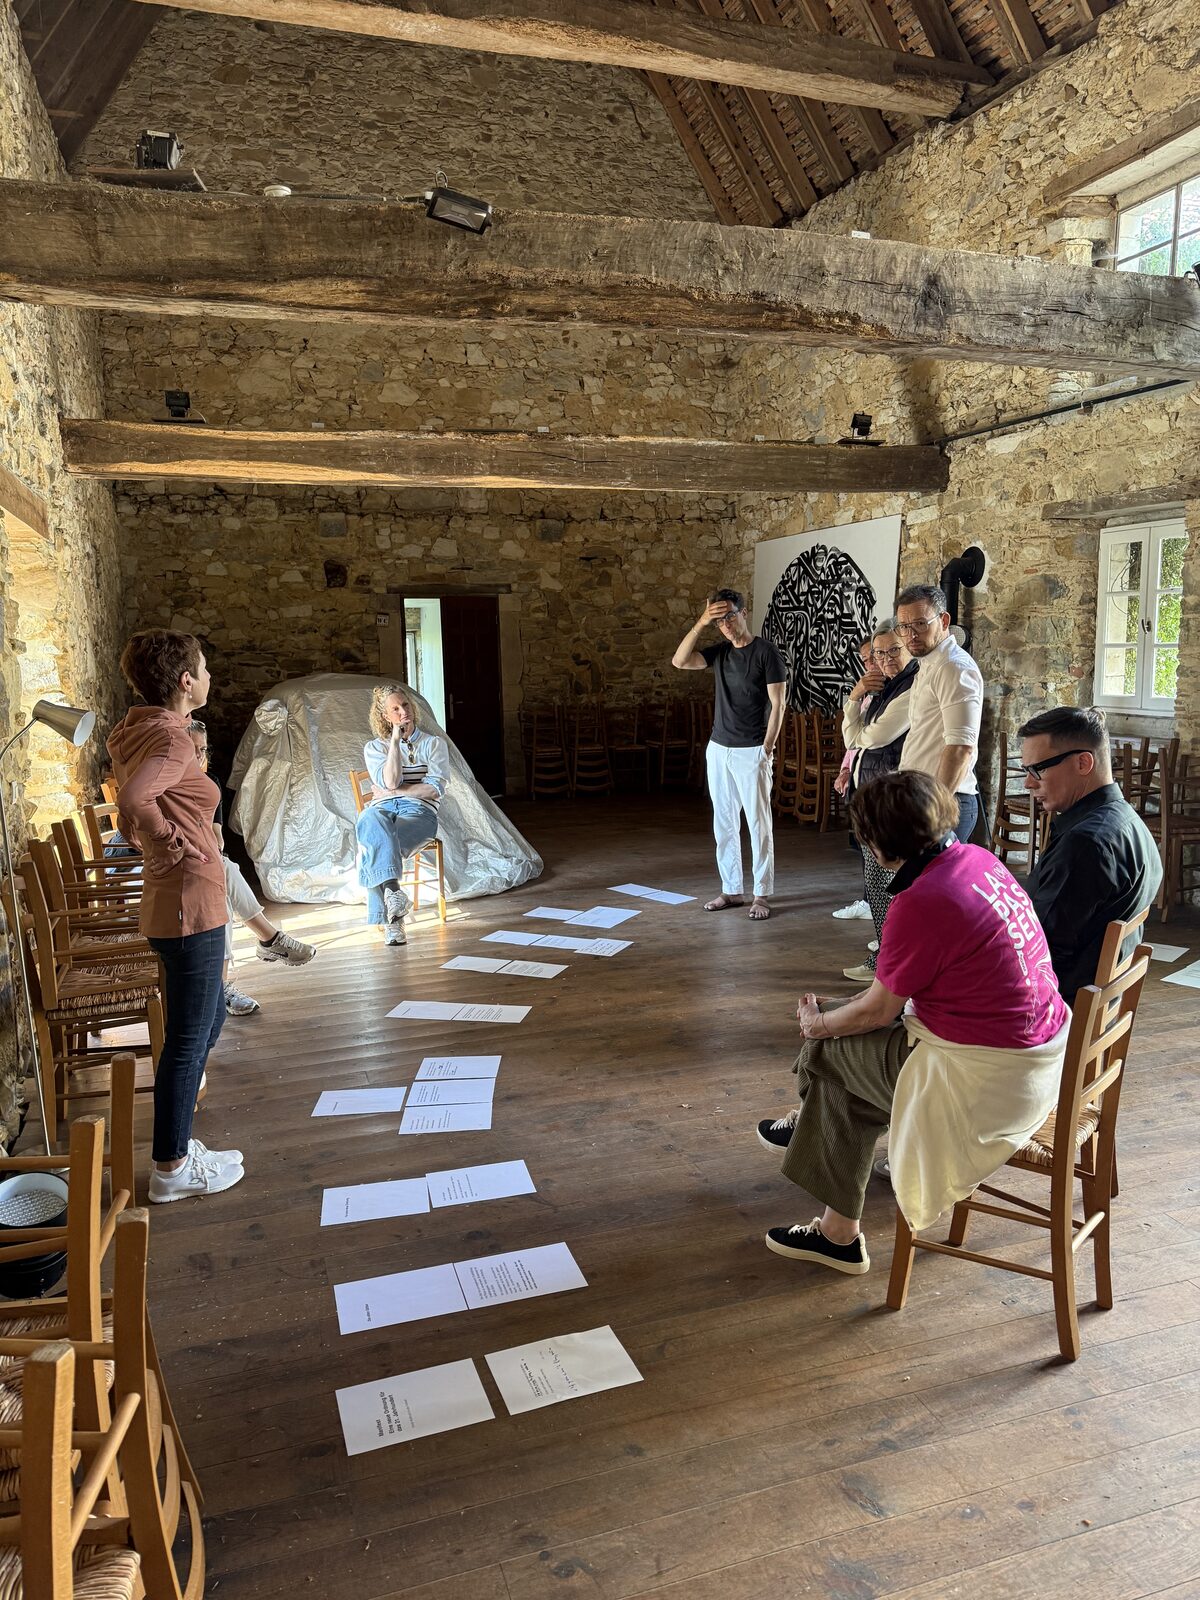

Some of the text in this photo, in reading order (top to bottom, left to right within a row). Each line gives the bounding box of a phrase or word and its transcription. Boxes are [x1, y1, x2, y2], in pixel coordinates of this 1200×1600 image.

[972, 871, 1006, 904] LA
[992, 884, 1030, 926] PAS
[381, 1397, 389, 1414] Ordnung
[388, 1394, 398, 1417] Jahrhundert
[376, 1419, 384, 1437] Manifest
